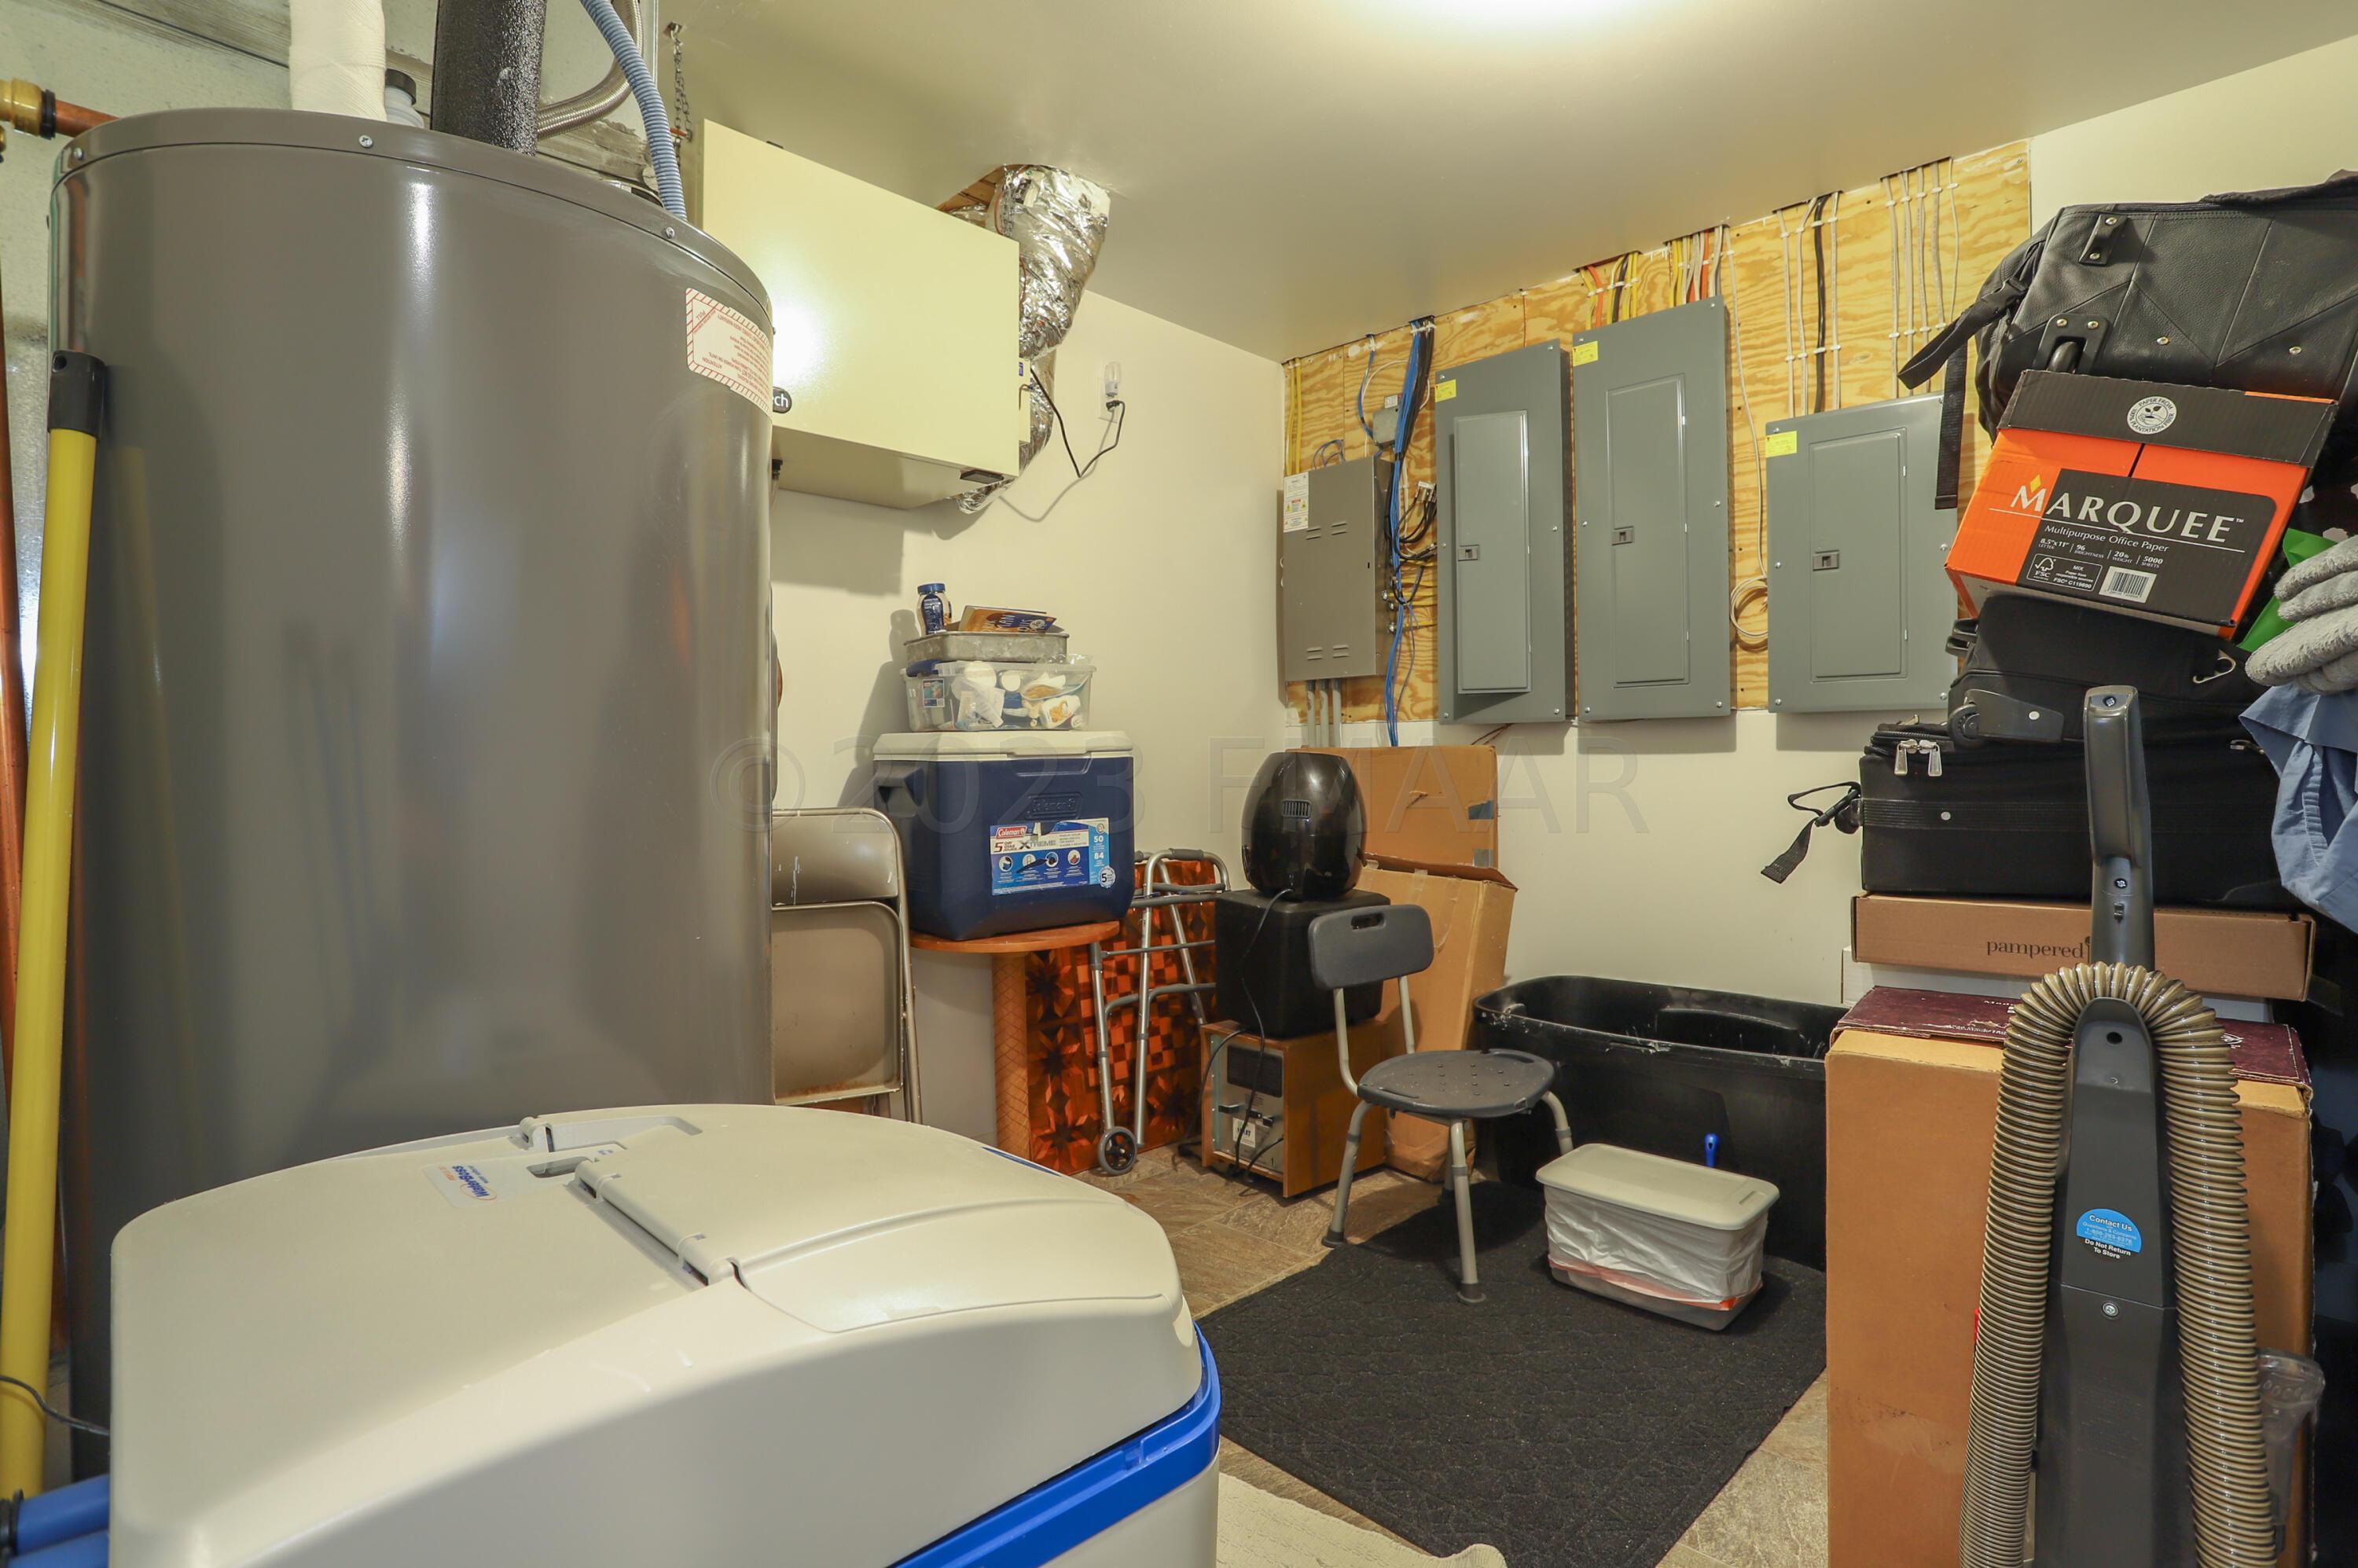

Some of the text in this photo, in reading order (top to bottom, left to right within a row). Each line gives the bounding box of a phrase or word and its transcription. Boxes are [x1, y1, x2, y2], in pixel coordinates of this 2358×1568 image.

[2138, 398, 2174, 410] PAPER FROM
[2044, 524, 2169, 553] Multipurpose Office Paper
[2143, 556, 2164, 564] 5000
[998, 828, 1020, 837] Coleman
[1093, 835, 1104, 843] 50
[994, 842, 1004, 853] 5
[1100, 872, 1107, 883] 5
[1986, 941, 2084, 959] pampered
[2089, 1215, 2132, 1232] Contact Us
[2084, 1238, 2132, 1256] Do Not Return
[2102, 1250, 2121, 1259] Store
